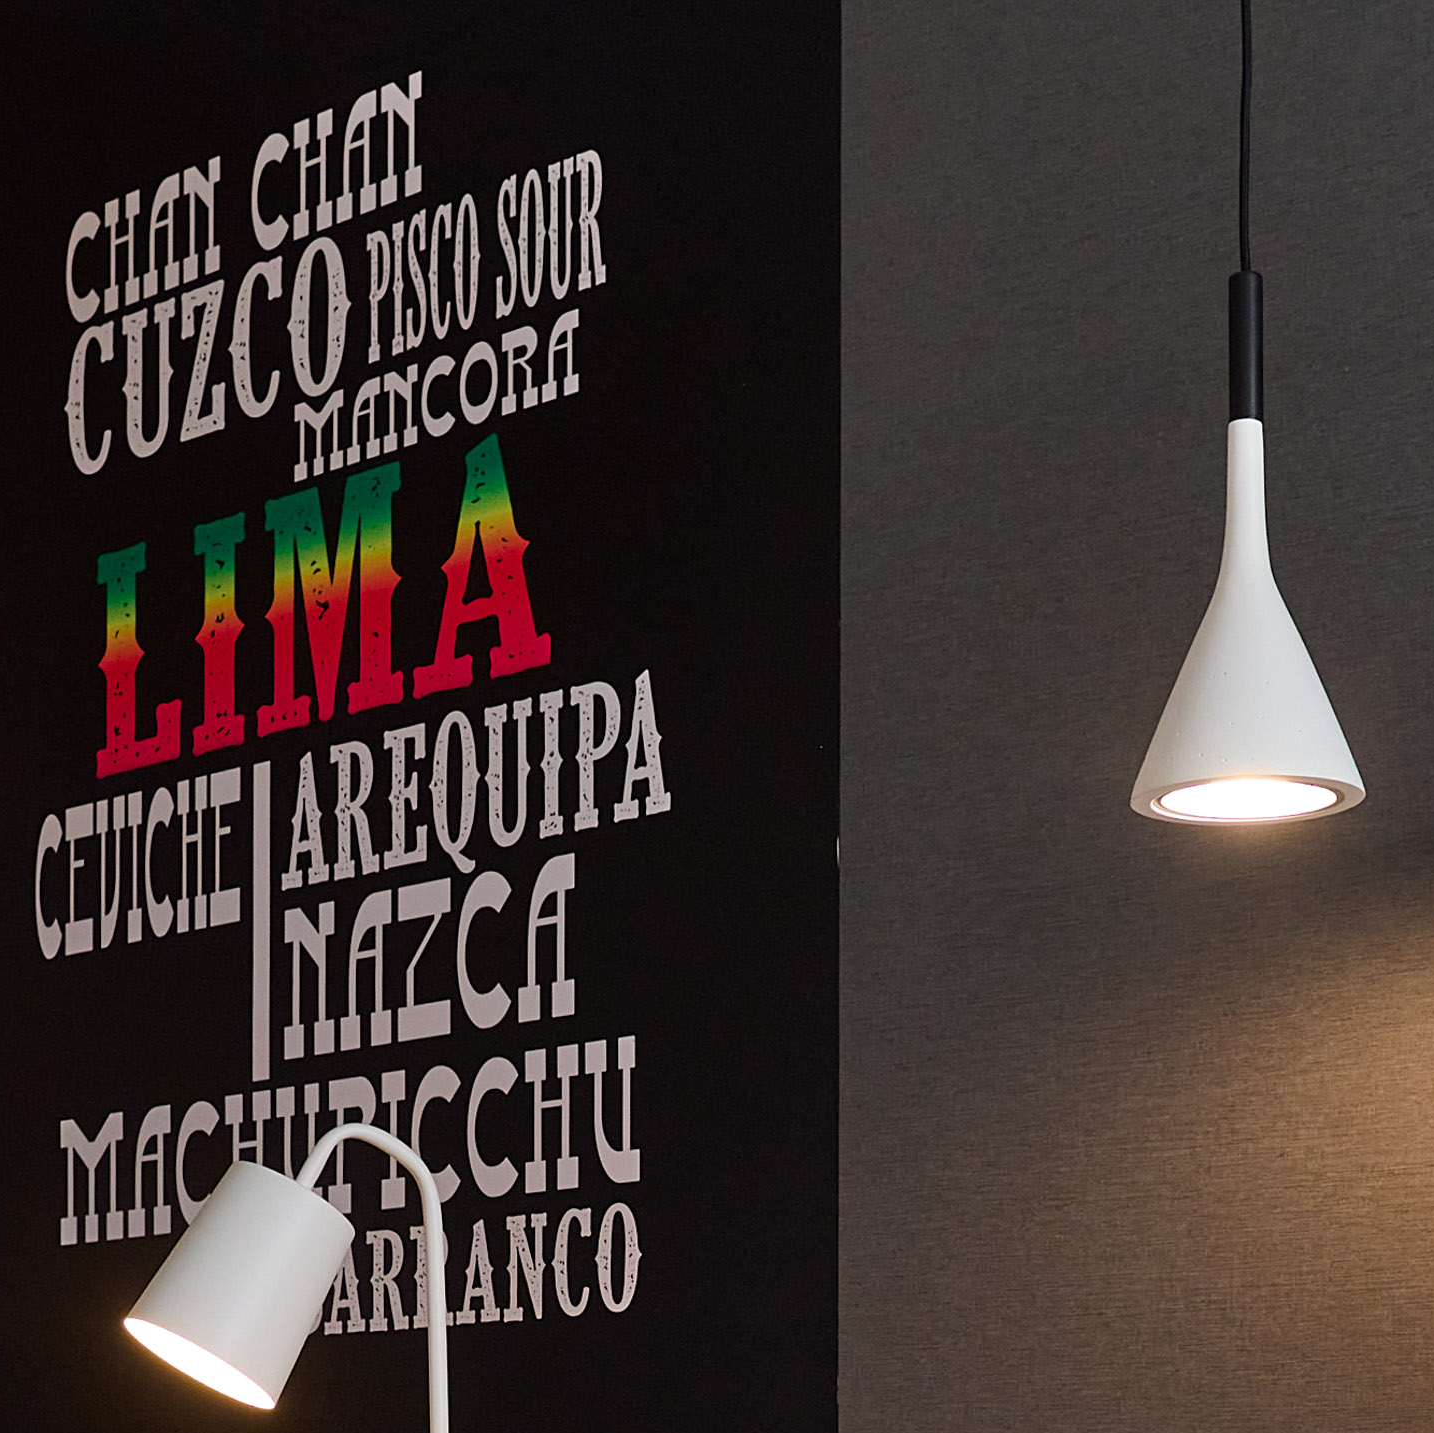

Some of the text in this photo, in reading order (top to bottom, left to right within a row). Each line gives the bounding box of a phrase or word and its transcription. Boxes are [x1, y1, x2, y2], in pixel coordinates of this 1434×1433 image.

[67, 70, 422, 322] CHAN CHAN
[367, 149, 606, 363] PISCO SOUR
[65, 237, 351, 474] CUZCO
[294, 309, 579, 482] MANCORA
[96, 432, 551, 779] LIMA
[35, 767, 241, 959] CEVICHE
[281, 669, 671, 891] AREQUIPA
[284, 853, 575, 1059] NAZCA
[306, 1202, 642, 1336] ARRANCO
